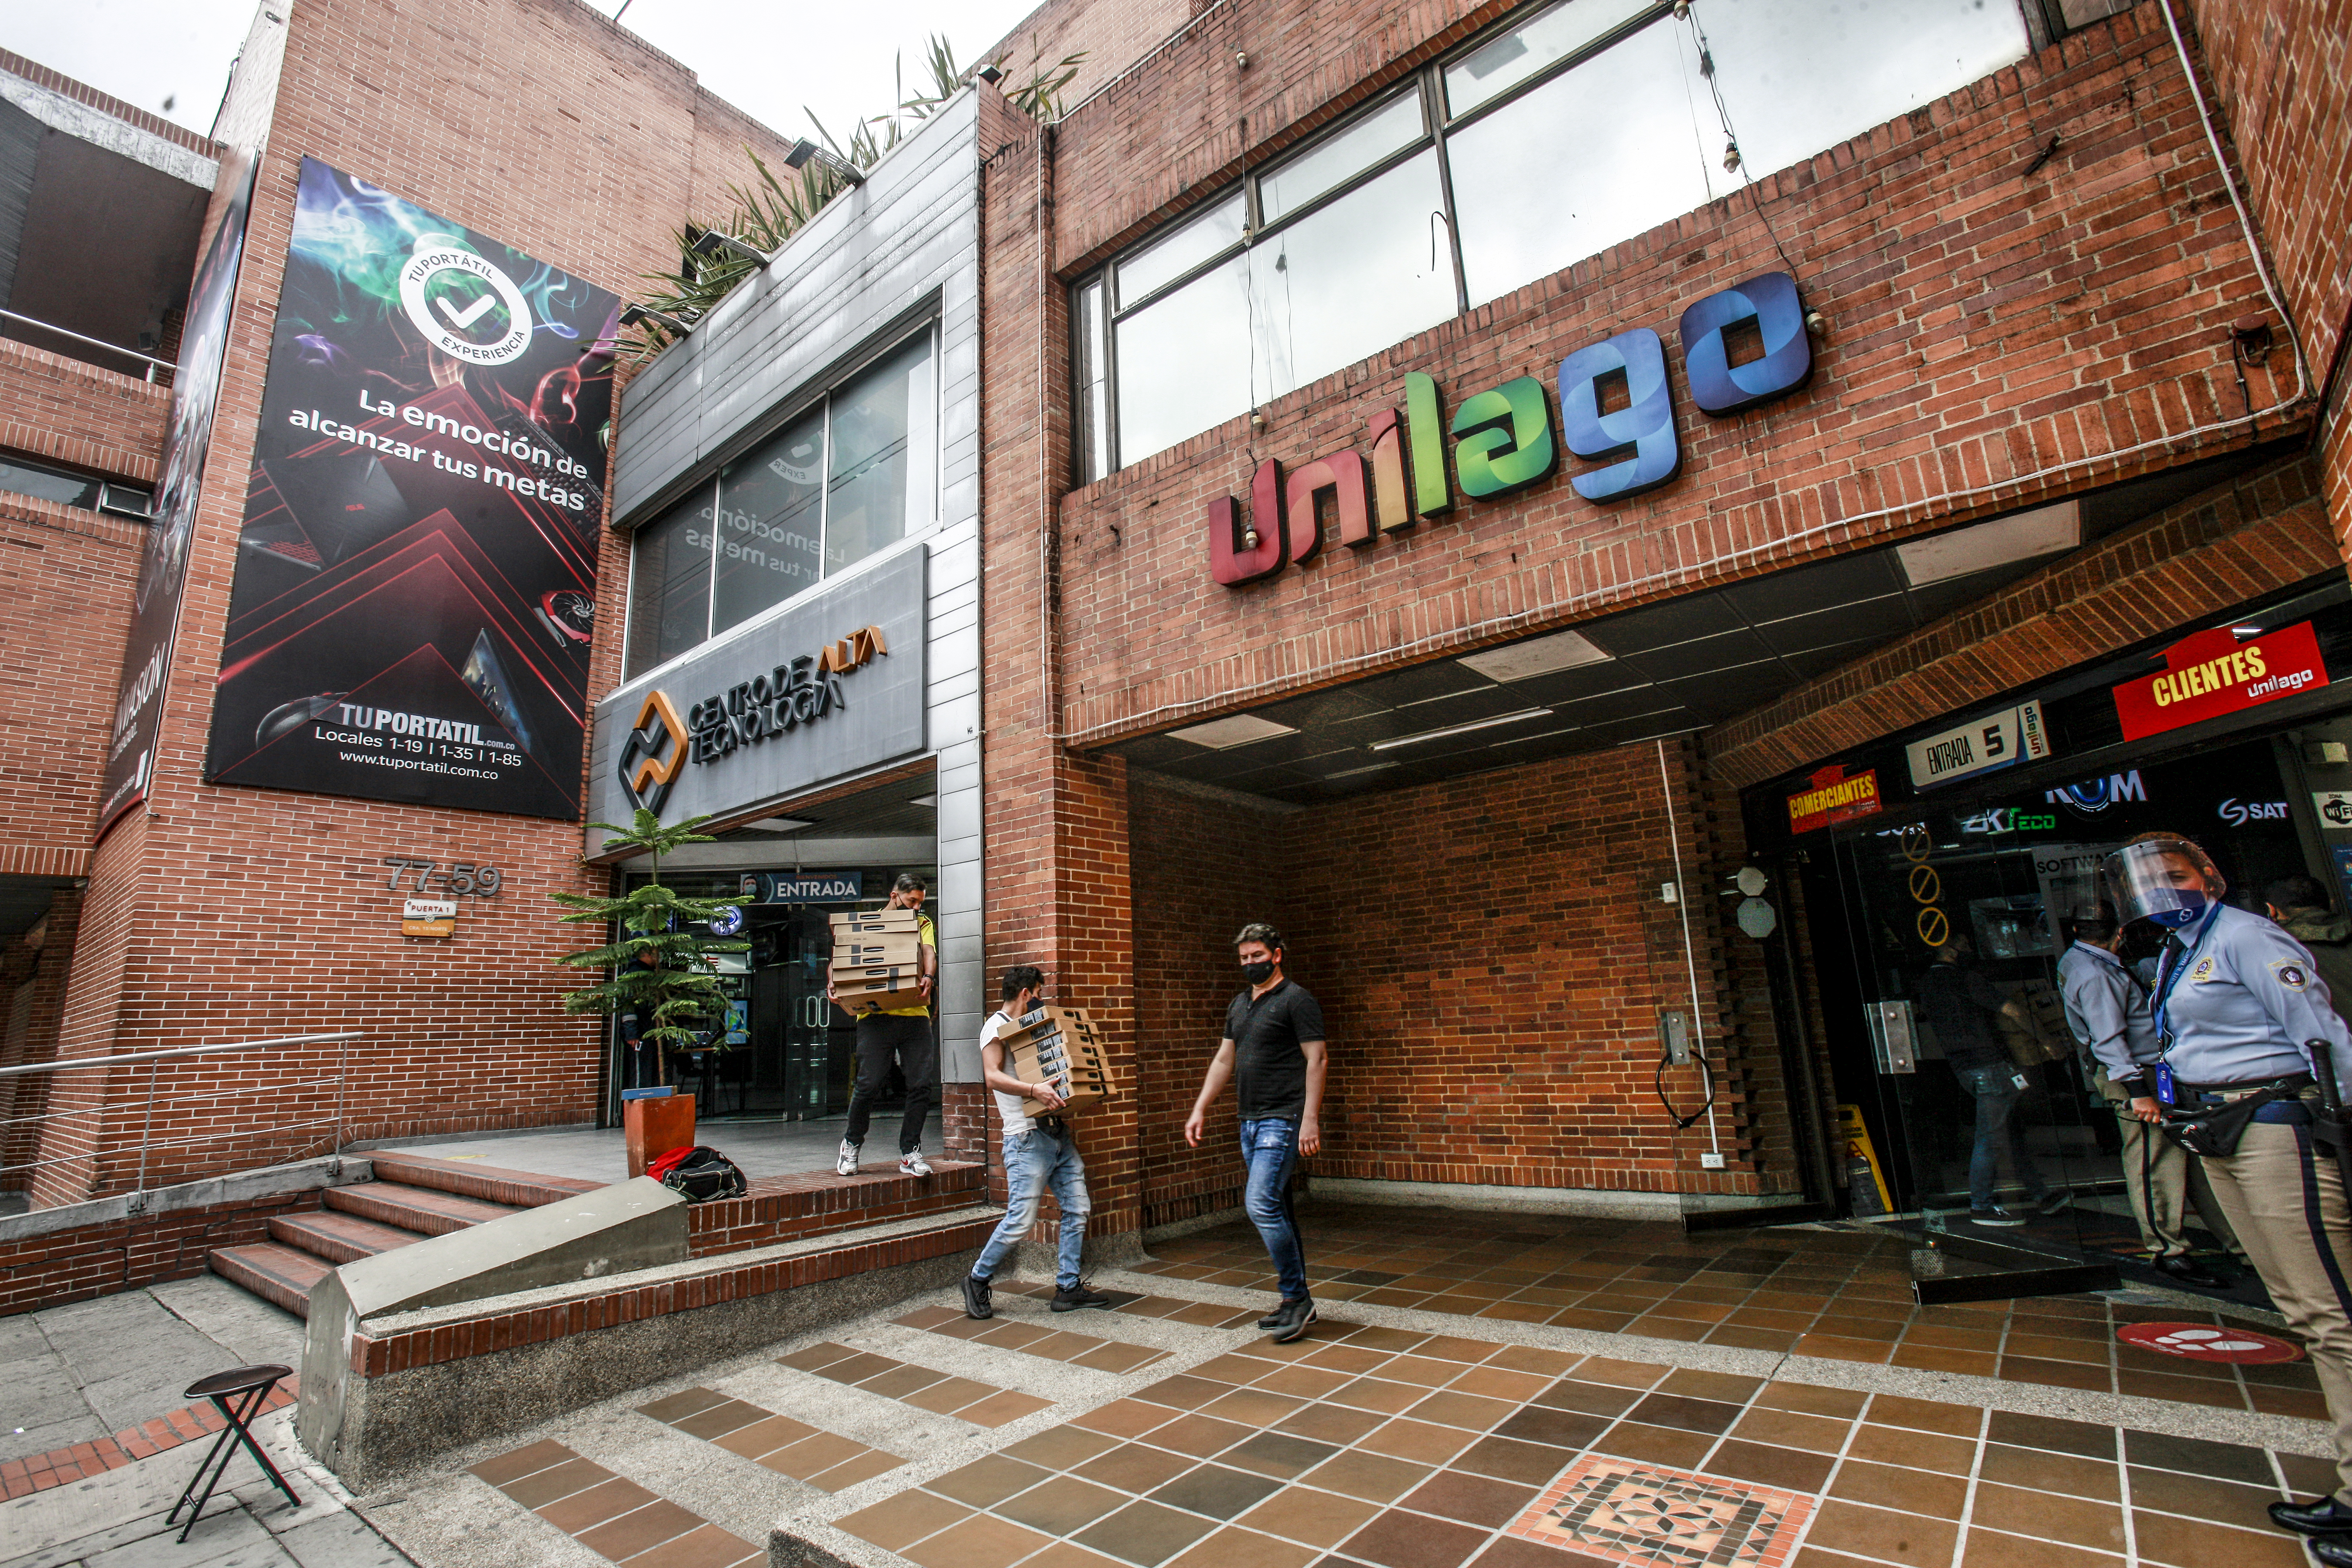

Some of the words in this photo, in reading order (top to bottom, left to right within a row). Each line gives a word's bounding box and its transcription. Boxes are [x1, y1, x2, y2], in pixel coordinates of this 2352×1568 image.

[442, 331, 525, 359] EXPERIENCIA
[360, 389, 395, 419] La
[402, 405, 551, 468] emoción
[556, 456, 588, 479] de
[1208, 271, 1814, 587] unilago
[289, 409, 426, 462] alcanzar
[432, 449, 477, 479] tus
[484, 465, 585, 511] metas
[689, 675, 770, 733] CENTRO
[772, 654, 814, 699] DE
[815, 625, 888, 681] ALTA
[2152, 646, 2266, 706] CLIENTES
[2247, 669, 2313, 697] unilago
[315, 726, 382, 747] Locales
[389, 737, 423, 753] 1-19
[440, 745, 474, 760] 1-35
[489, 752, 522, 767] 1-85
[340, 752, 498, 780] www.tuportatil.com.co
[1926, 736, 1974, 775] ENTRADA
[1983, 724, 2004, 757] 5
[1790, 775, 1875, 818] COMERCIANTES
[386, 859, 501, 896] 77-59
[777, 881, 857, 896] ENTRADA
